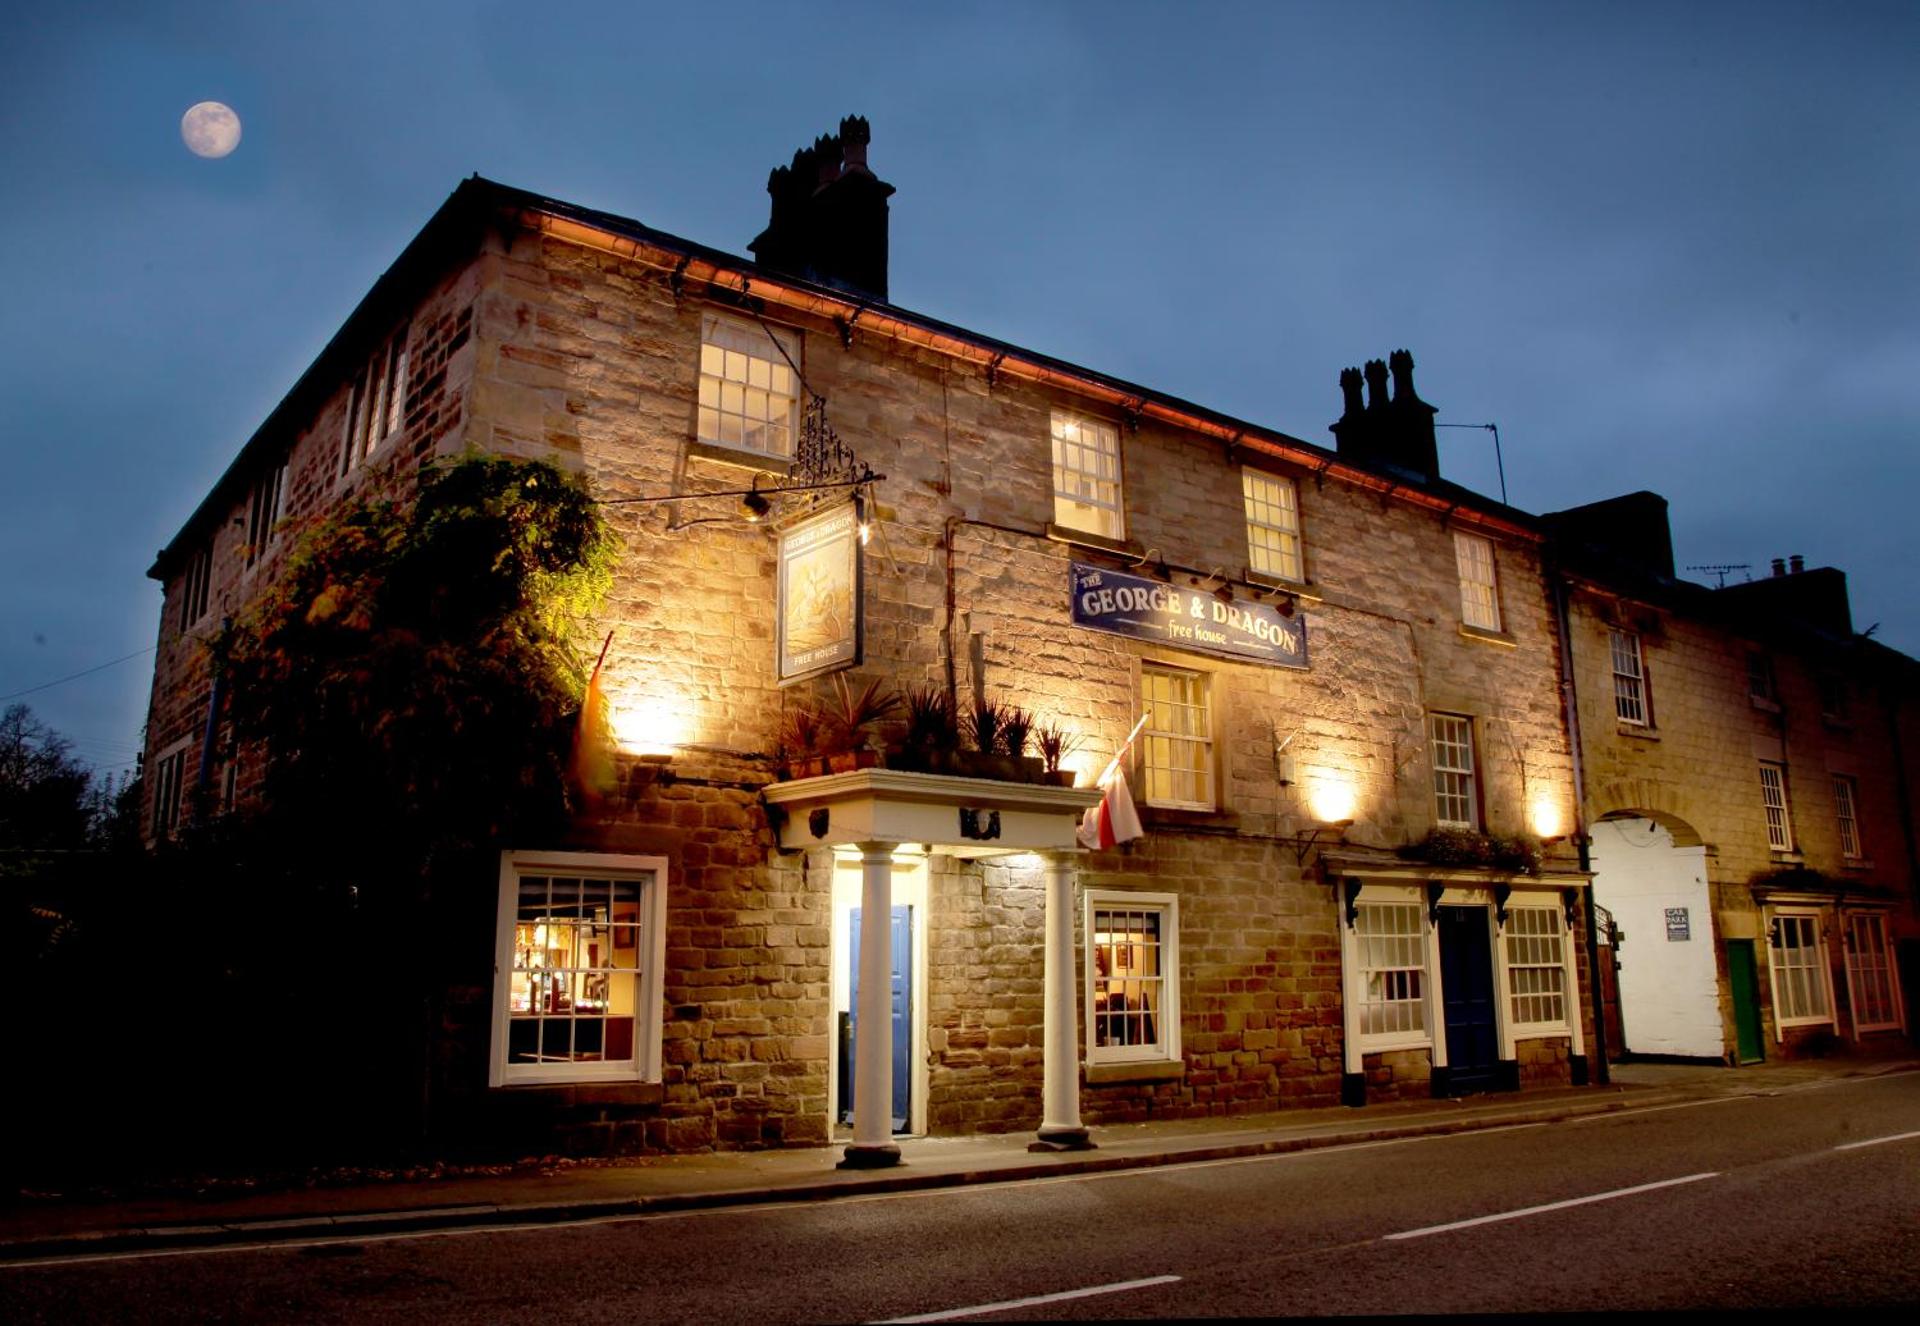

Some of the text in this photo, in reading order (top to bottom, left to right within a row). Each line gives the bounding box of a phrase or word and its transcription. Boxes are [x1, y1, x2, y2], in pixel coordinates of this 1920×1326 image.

[1081, 572, 1102, 588] THE
[1082, 587, 1297, 655] GEORGE & DRAGON
[1168, 619, 1227, 645] free house
[793, 653, 812, 666] FREE
